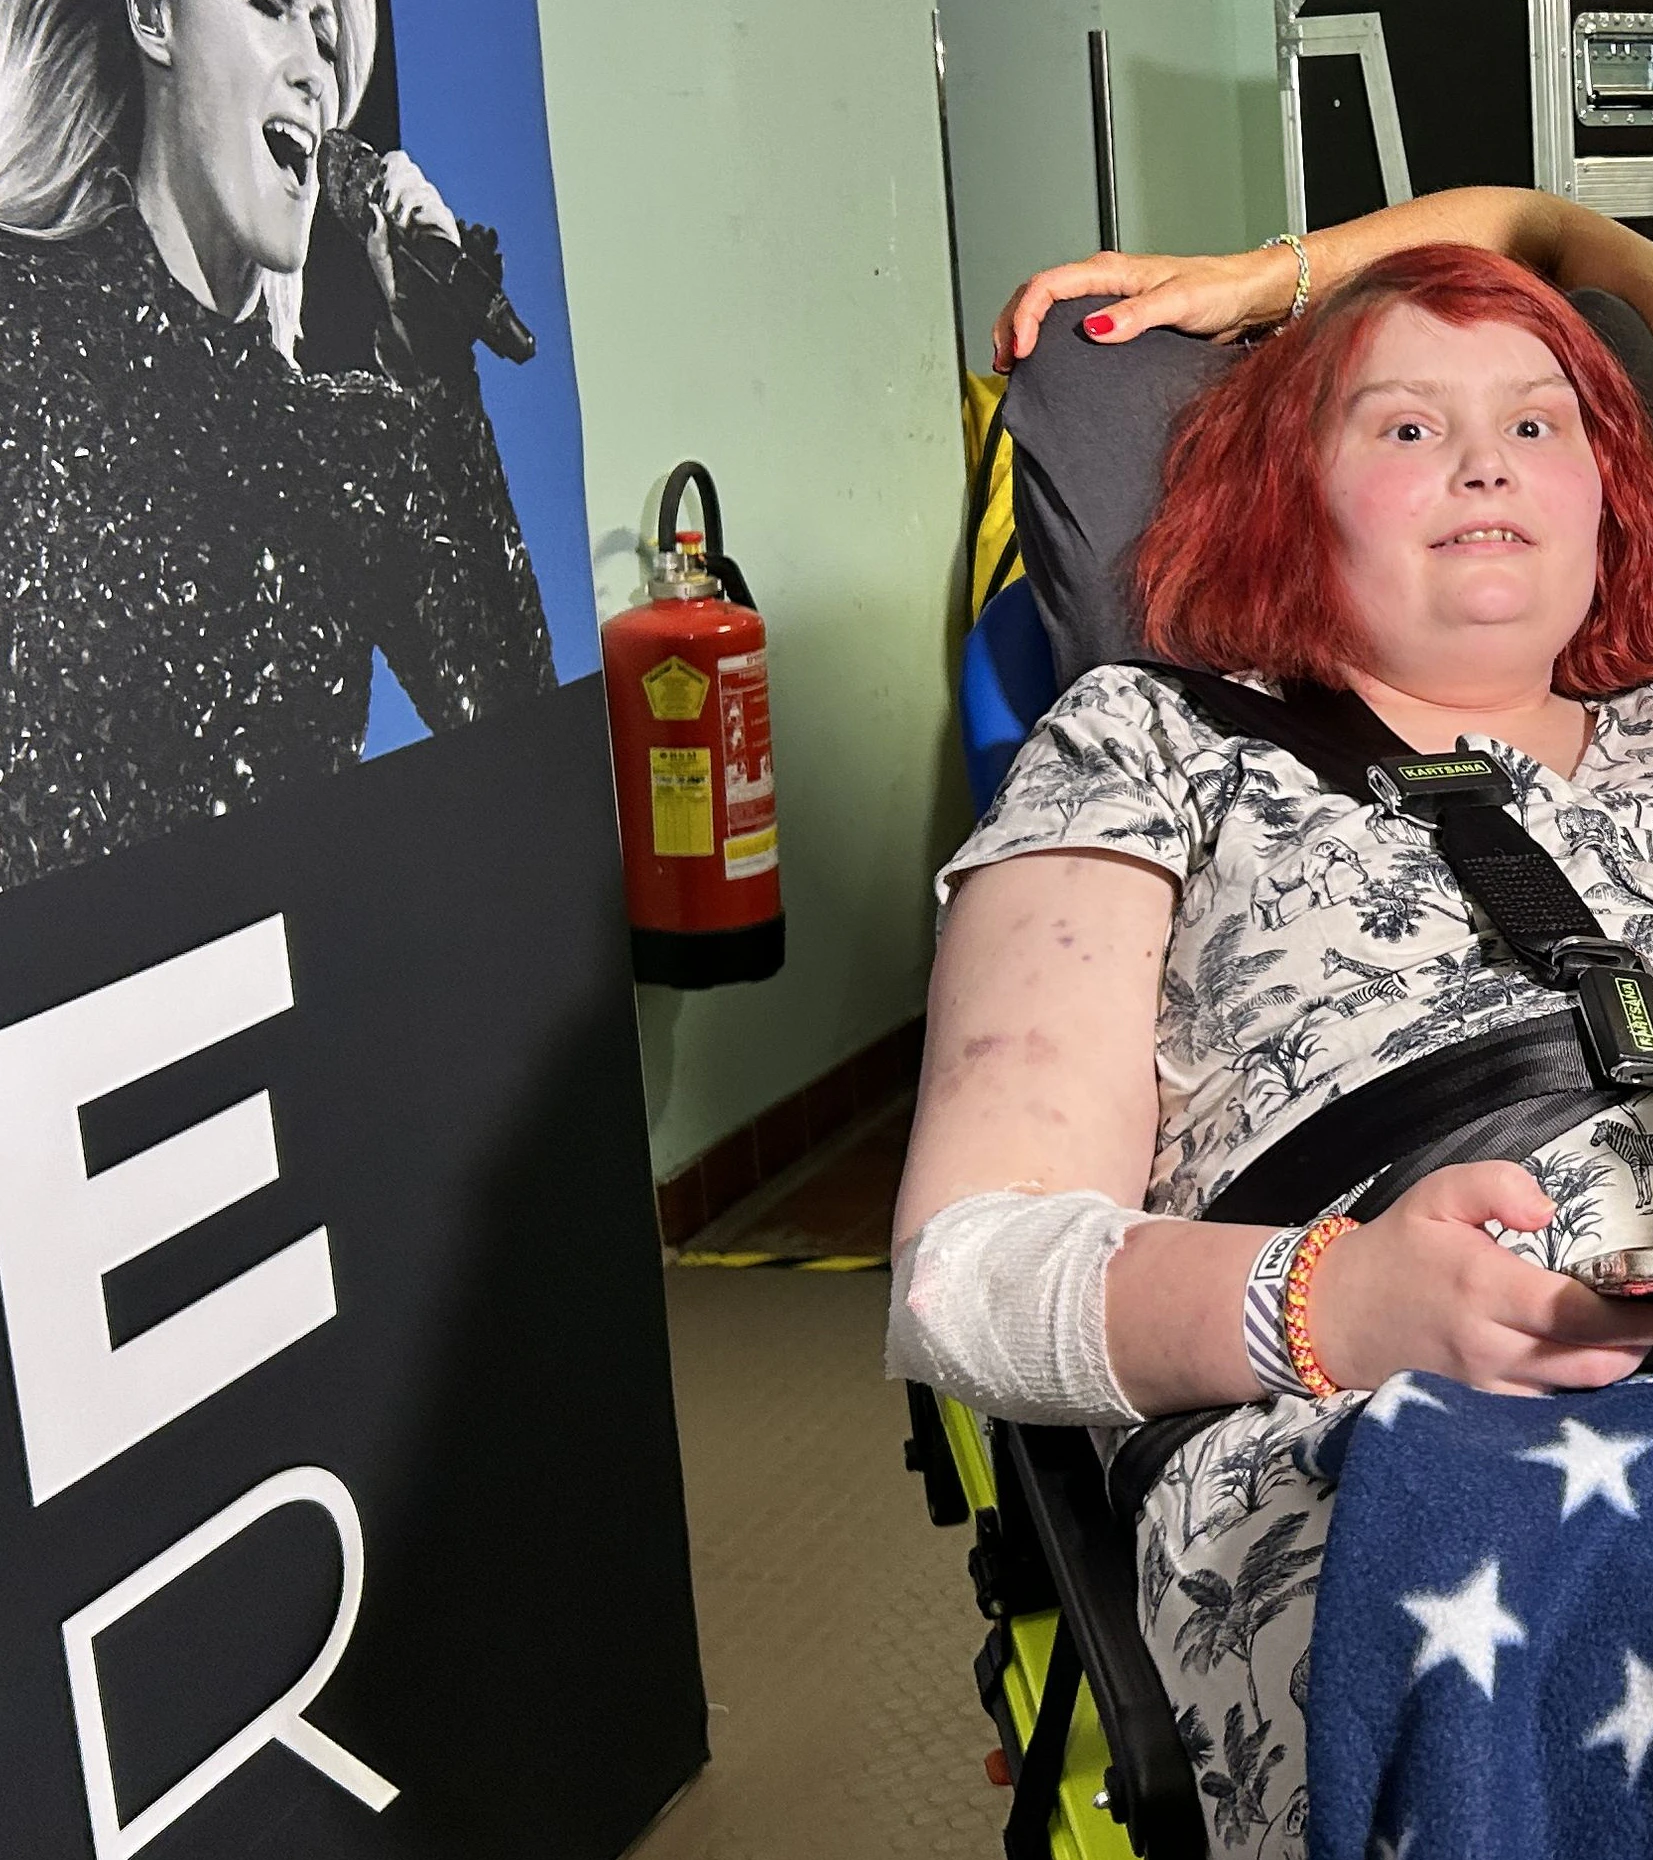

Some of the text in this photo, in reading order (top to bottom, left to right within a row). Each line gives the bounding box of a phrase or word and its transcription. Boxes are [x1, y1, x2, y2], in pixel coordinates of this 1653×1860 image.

[1404, 763, 1486, 778] KARTSANA
[1621, 983, 1653, 1047] KARTSANA
[62, 1465, 401, 1860] R
